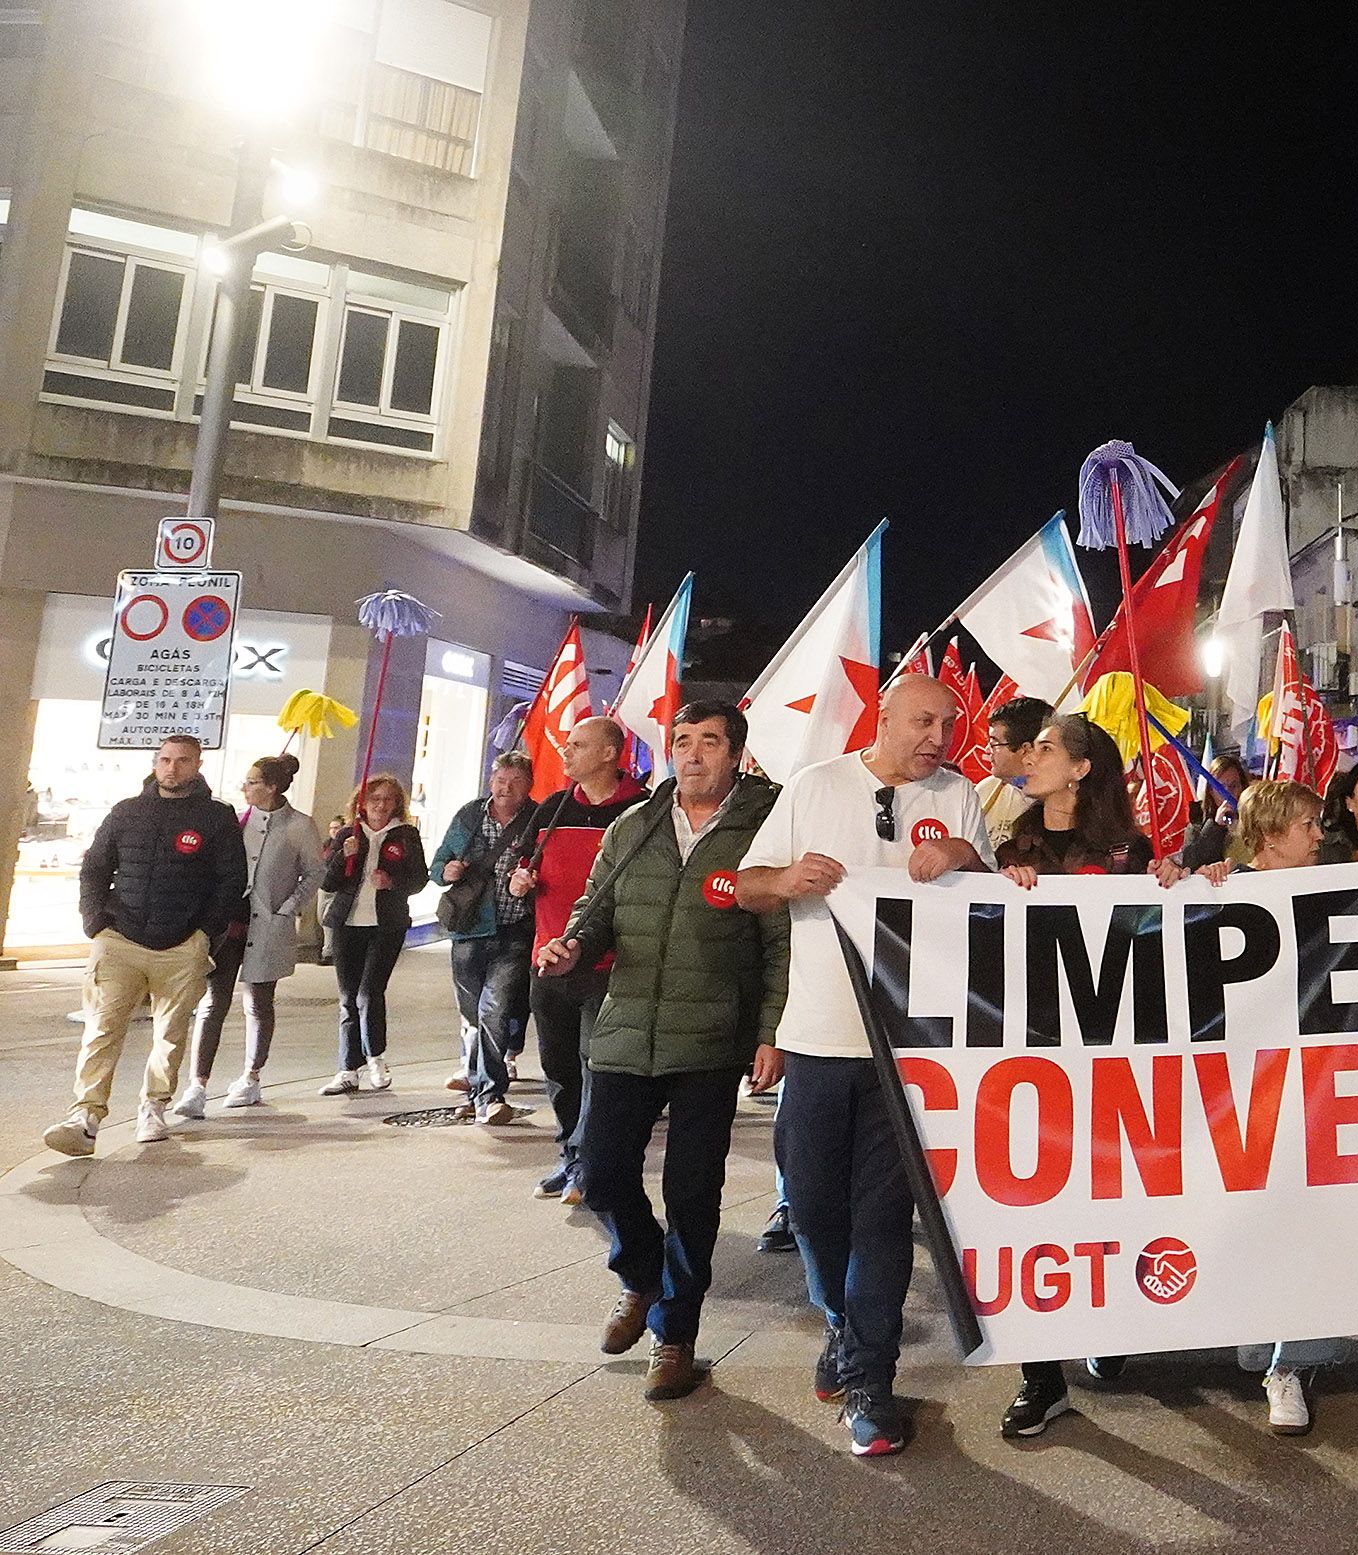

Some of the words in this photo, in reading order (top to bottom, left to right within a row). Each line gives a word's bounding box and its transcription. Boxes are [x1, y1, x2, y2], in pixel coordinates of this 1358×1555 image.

[175, 537, 194, 550] 10
[150, 648, 191, 660] AGÁS
[137, 664, 200, 673] BICICLETAS
[110, 678, 146, 686] CARGA
[152, 678, 159, 686] E
[165, 678, 225, 687] DESCARGA
[107, 689, 156, 698] LABORAIS
[162, 689, 175, 698] DE
[194, 689, 201, 698] A
[136, 700, 149, 709] DE
[172, 700, 179, 709] A
[136, 712, 149, 720] 30
[155, 712, 176, 721] MIN
[182, 712, 188, 720] E
[122, 726, 200, 735] AUTORIZADOS
[142, 738, 152, 746] 10
[918, 826, 942, 840] CIG
[712, 877, 735, 895] CIG
[962, 1241, 1120, 1317] UGT
